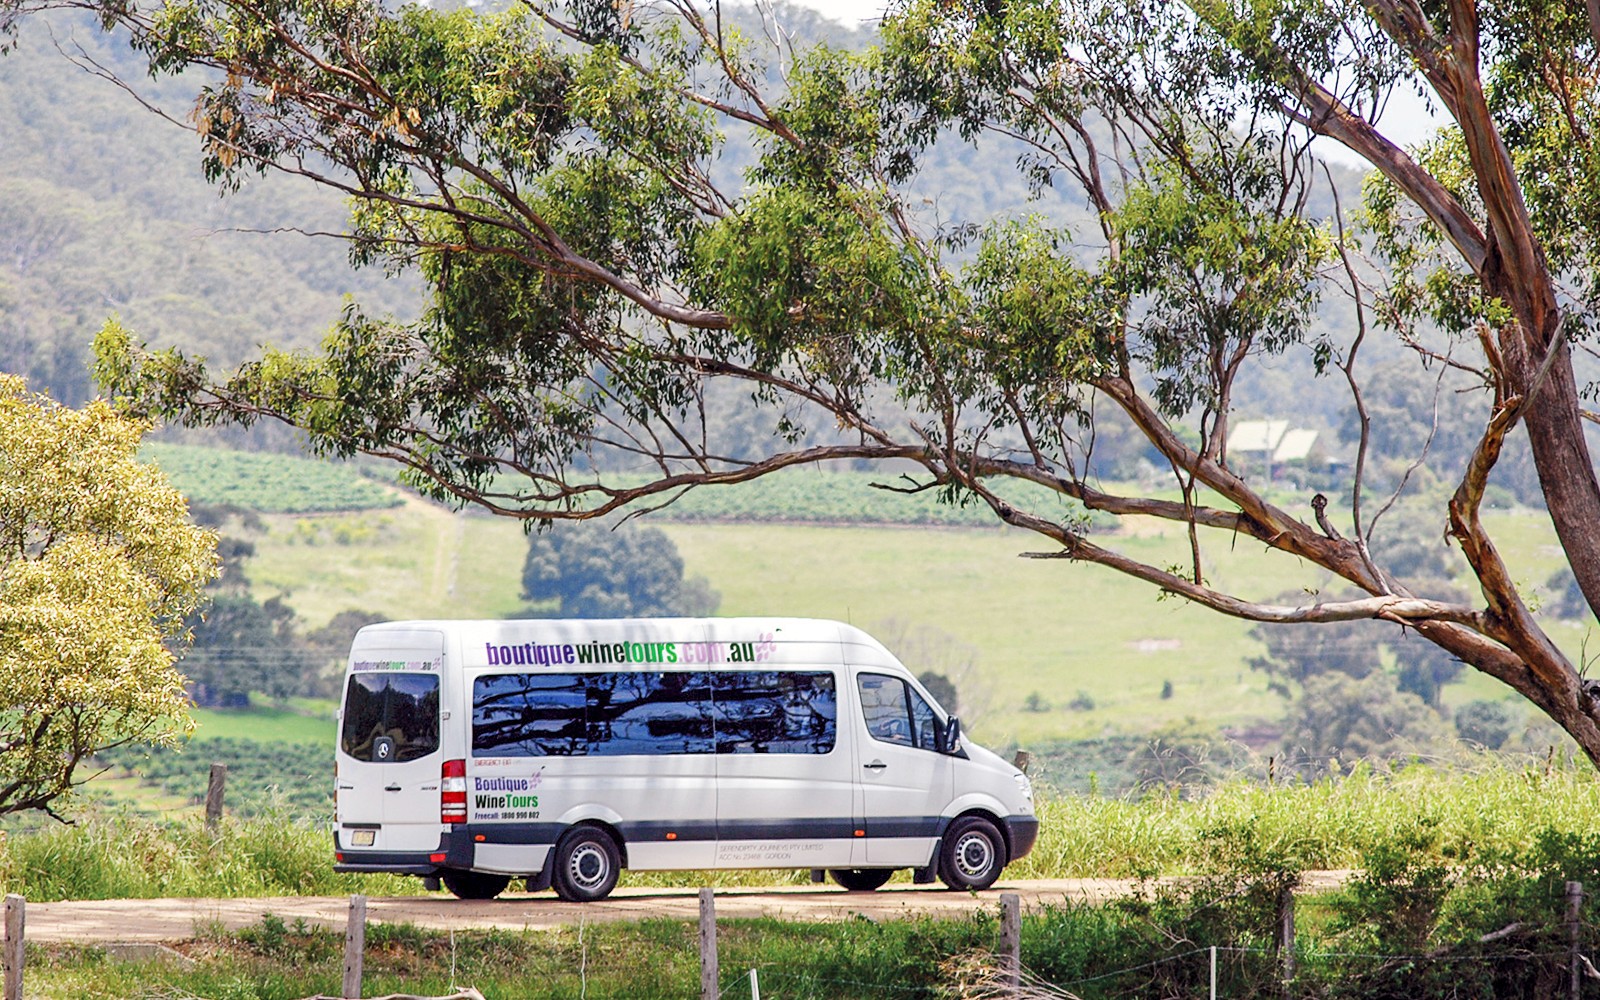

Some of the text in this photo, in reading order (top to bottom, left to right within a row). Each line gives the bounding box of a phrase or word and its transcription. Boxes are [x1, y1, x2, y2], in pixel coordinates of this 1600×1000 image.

[486, 640, 755, 667] boutiquewinetours.com.au
[475, 776, 528, 792] Boutique
[475, 794, 538, 808] WineTours
[501, 811, 515, 819] 1800
[516, 811, 528, 819] 990
